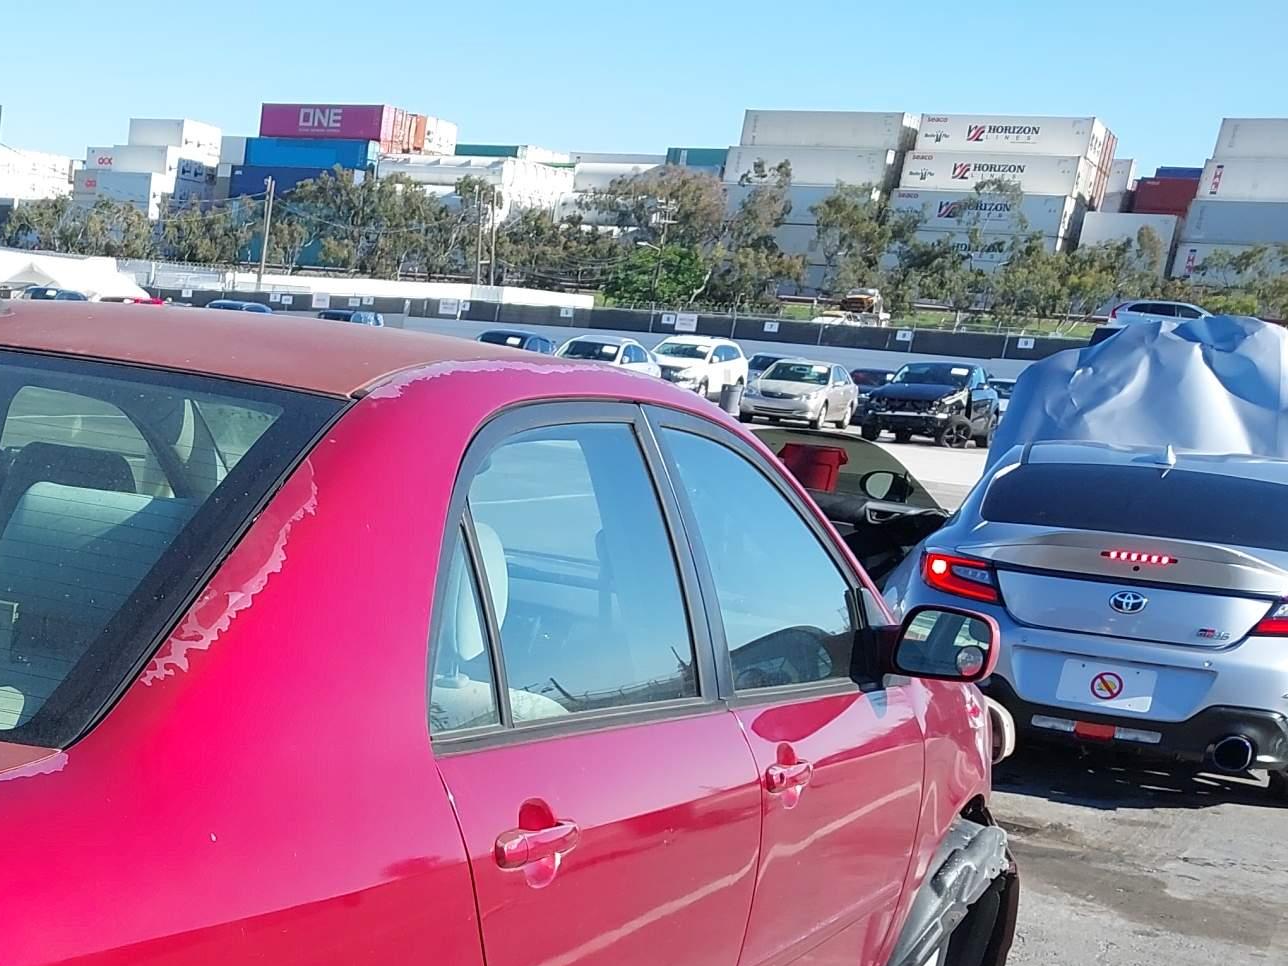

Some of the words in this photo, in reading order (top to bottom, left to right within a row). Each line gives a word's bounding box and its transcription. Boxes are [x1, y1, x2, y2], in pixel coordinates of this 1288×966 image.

[298, 108, 343, 128] ONE
[987, 125, 1041, 136] HORIZON
[97, 156, 113, 166] OOC
[972, 162, 1027, 174] HORIZON
[965, 200, 1012, 212] ORIZON
